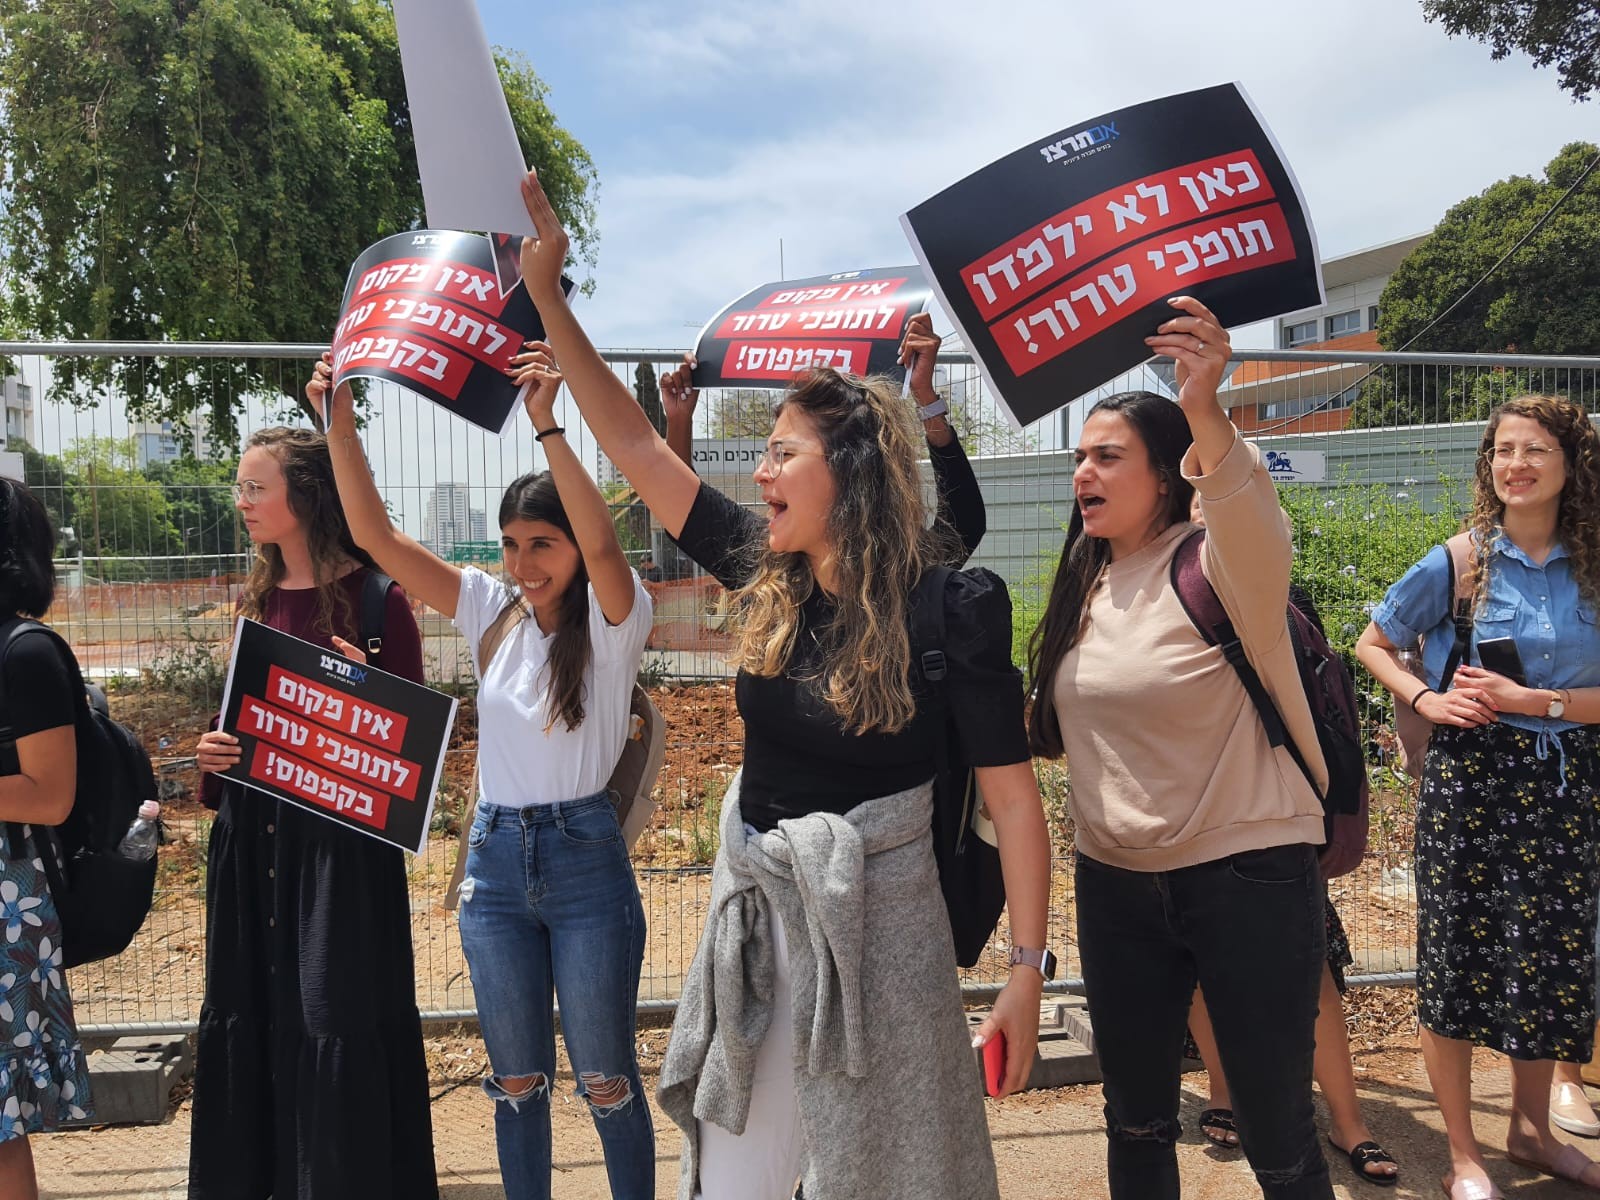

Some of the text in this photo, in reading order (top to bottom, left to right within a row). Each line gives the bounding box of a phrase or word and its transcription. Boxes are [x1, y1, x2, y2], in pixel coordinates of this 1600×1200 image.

[972, 160, 1261, 304] כאן לא ילמדו
[358, 263, 495, 301] אין מקום
[771, 282, 891, 304] אין מקום
[1014, 218, 1275, 353] תומכי טרור!
[382, 298, 507, 355] לתומכי
[732, 303, 897, 332] לתומכי טרור
[692, 450, 764, 462] וכים הבא
[278, 676, 393, 741] אין מקום
[250, 704, 410, 789] לתומכי טרור
[265, 752, 374, 817] בקמפוס!
